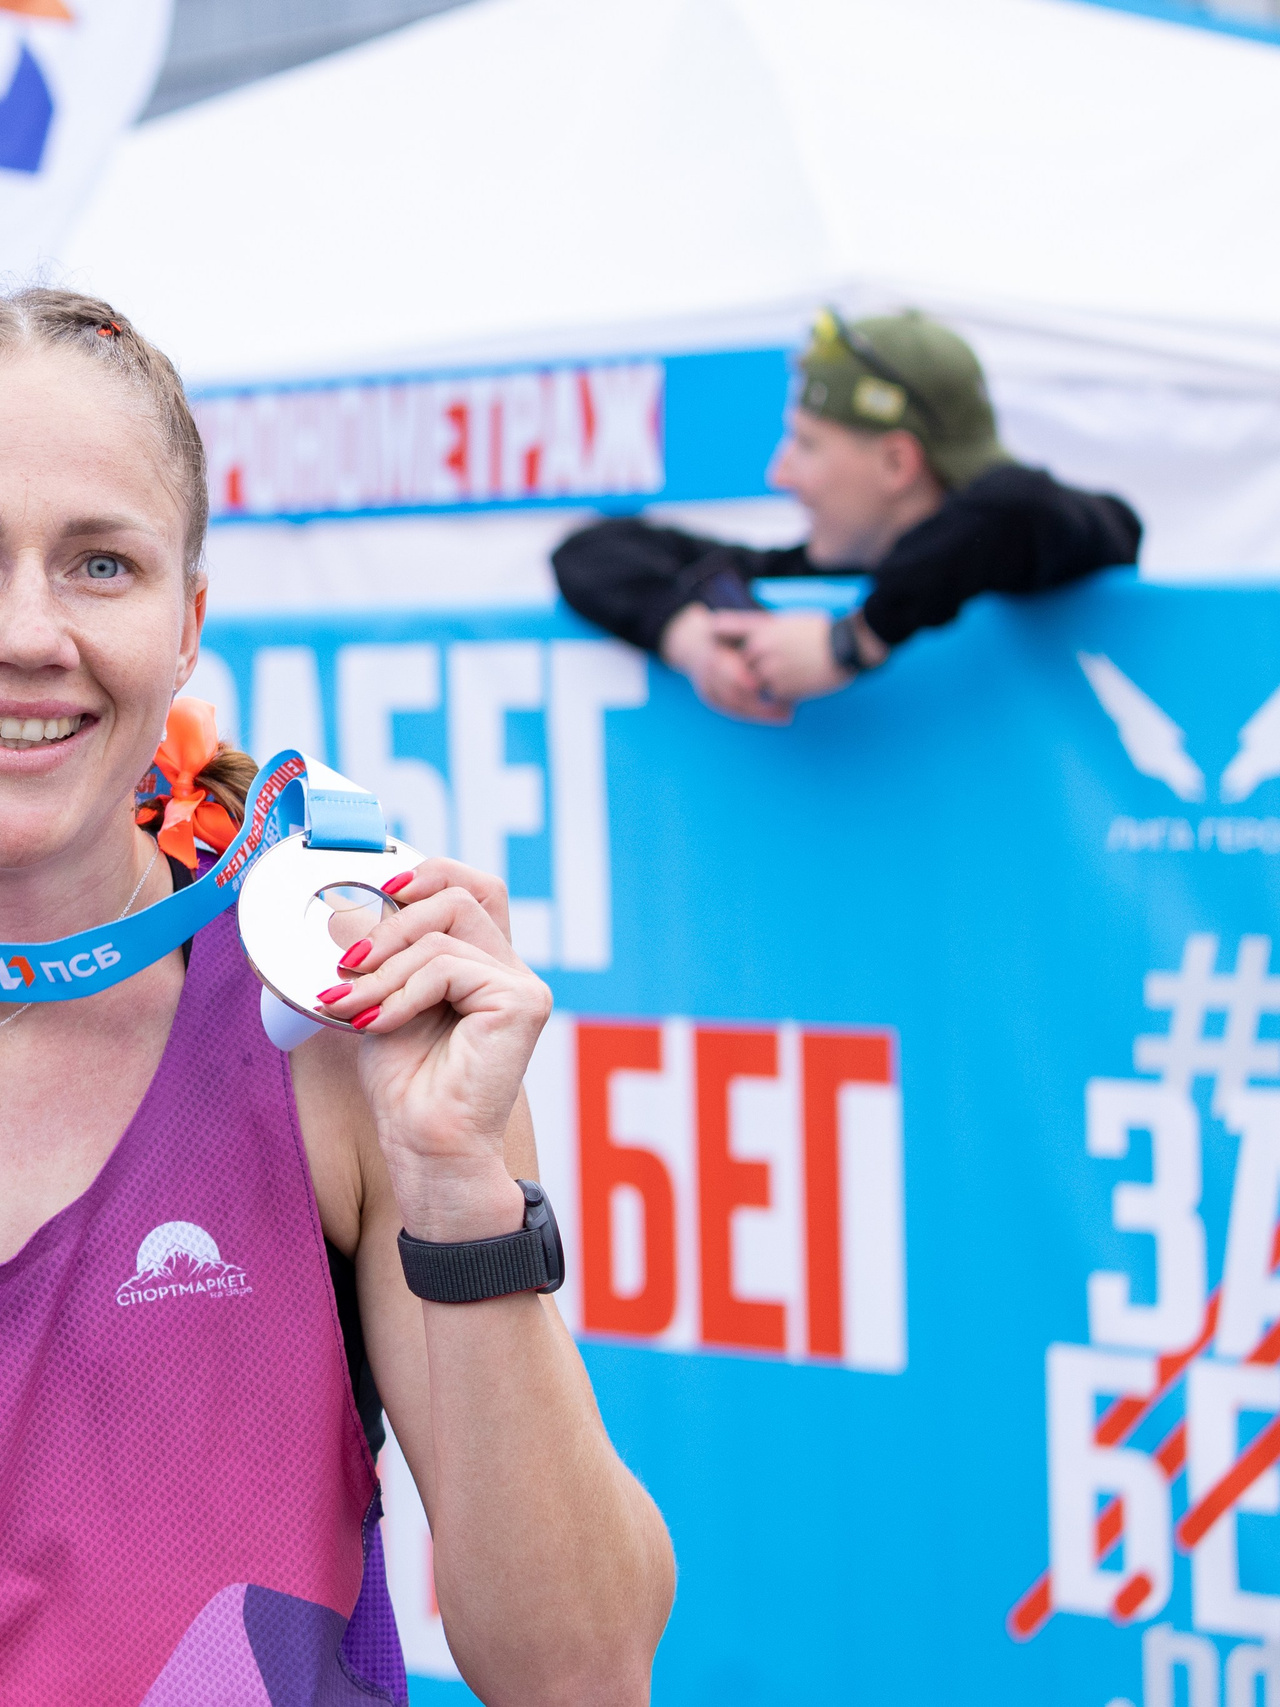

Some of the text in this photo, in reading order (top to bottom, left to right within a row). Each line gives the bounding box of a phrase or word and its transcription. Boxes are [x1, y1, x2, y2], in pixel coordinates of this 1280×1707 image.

[204, 360, 664, 512] РОНОМЕТРАЖ
[214, 757, 308, 888] #БЕГУ ВСЕМ СЕРДЦЕМ
[39, 942, 122, 984] ПСБ
[572, 1016, 904, 1370] БЕГ
[116, 1273, 247, 1306] СПОРТМАРКЕТ
